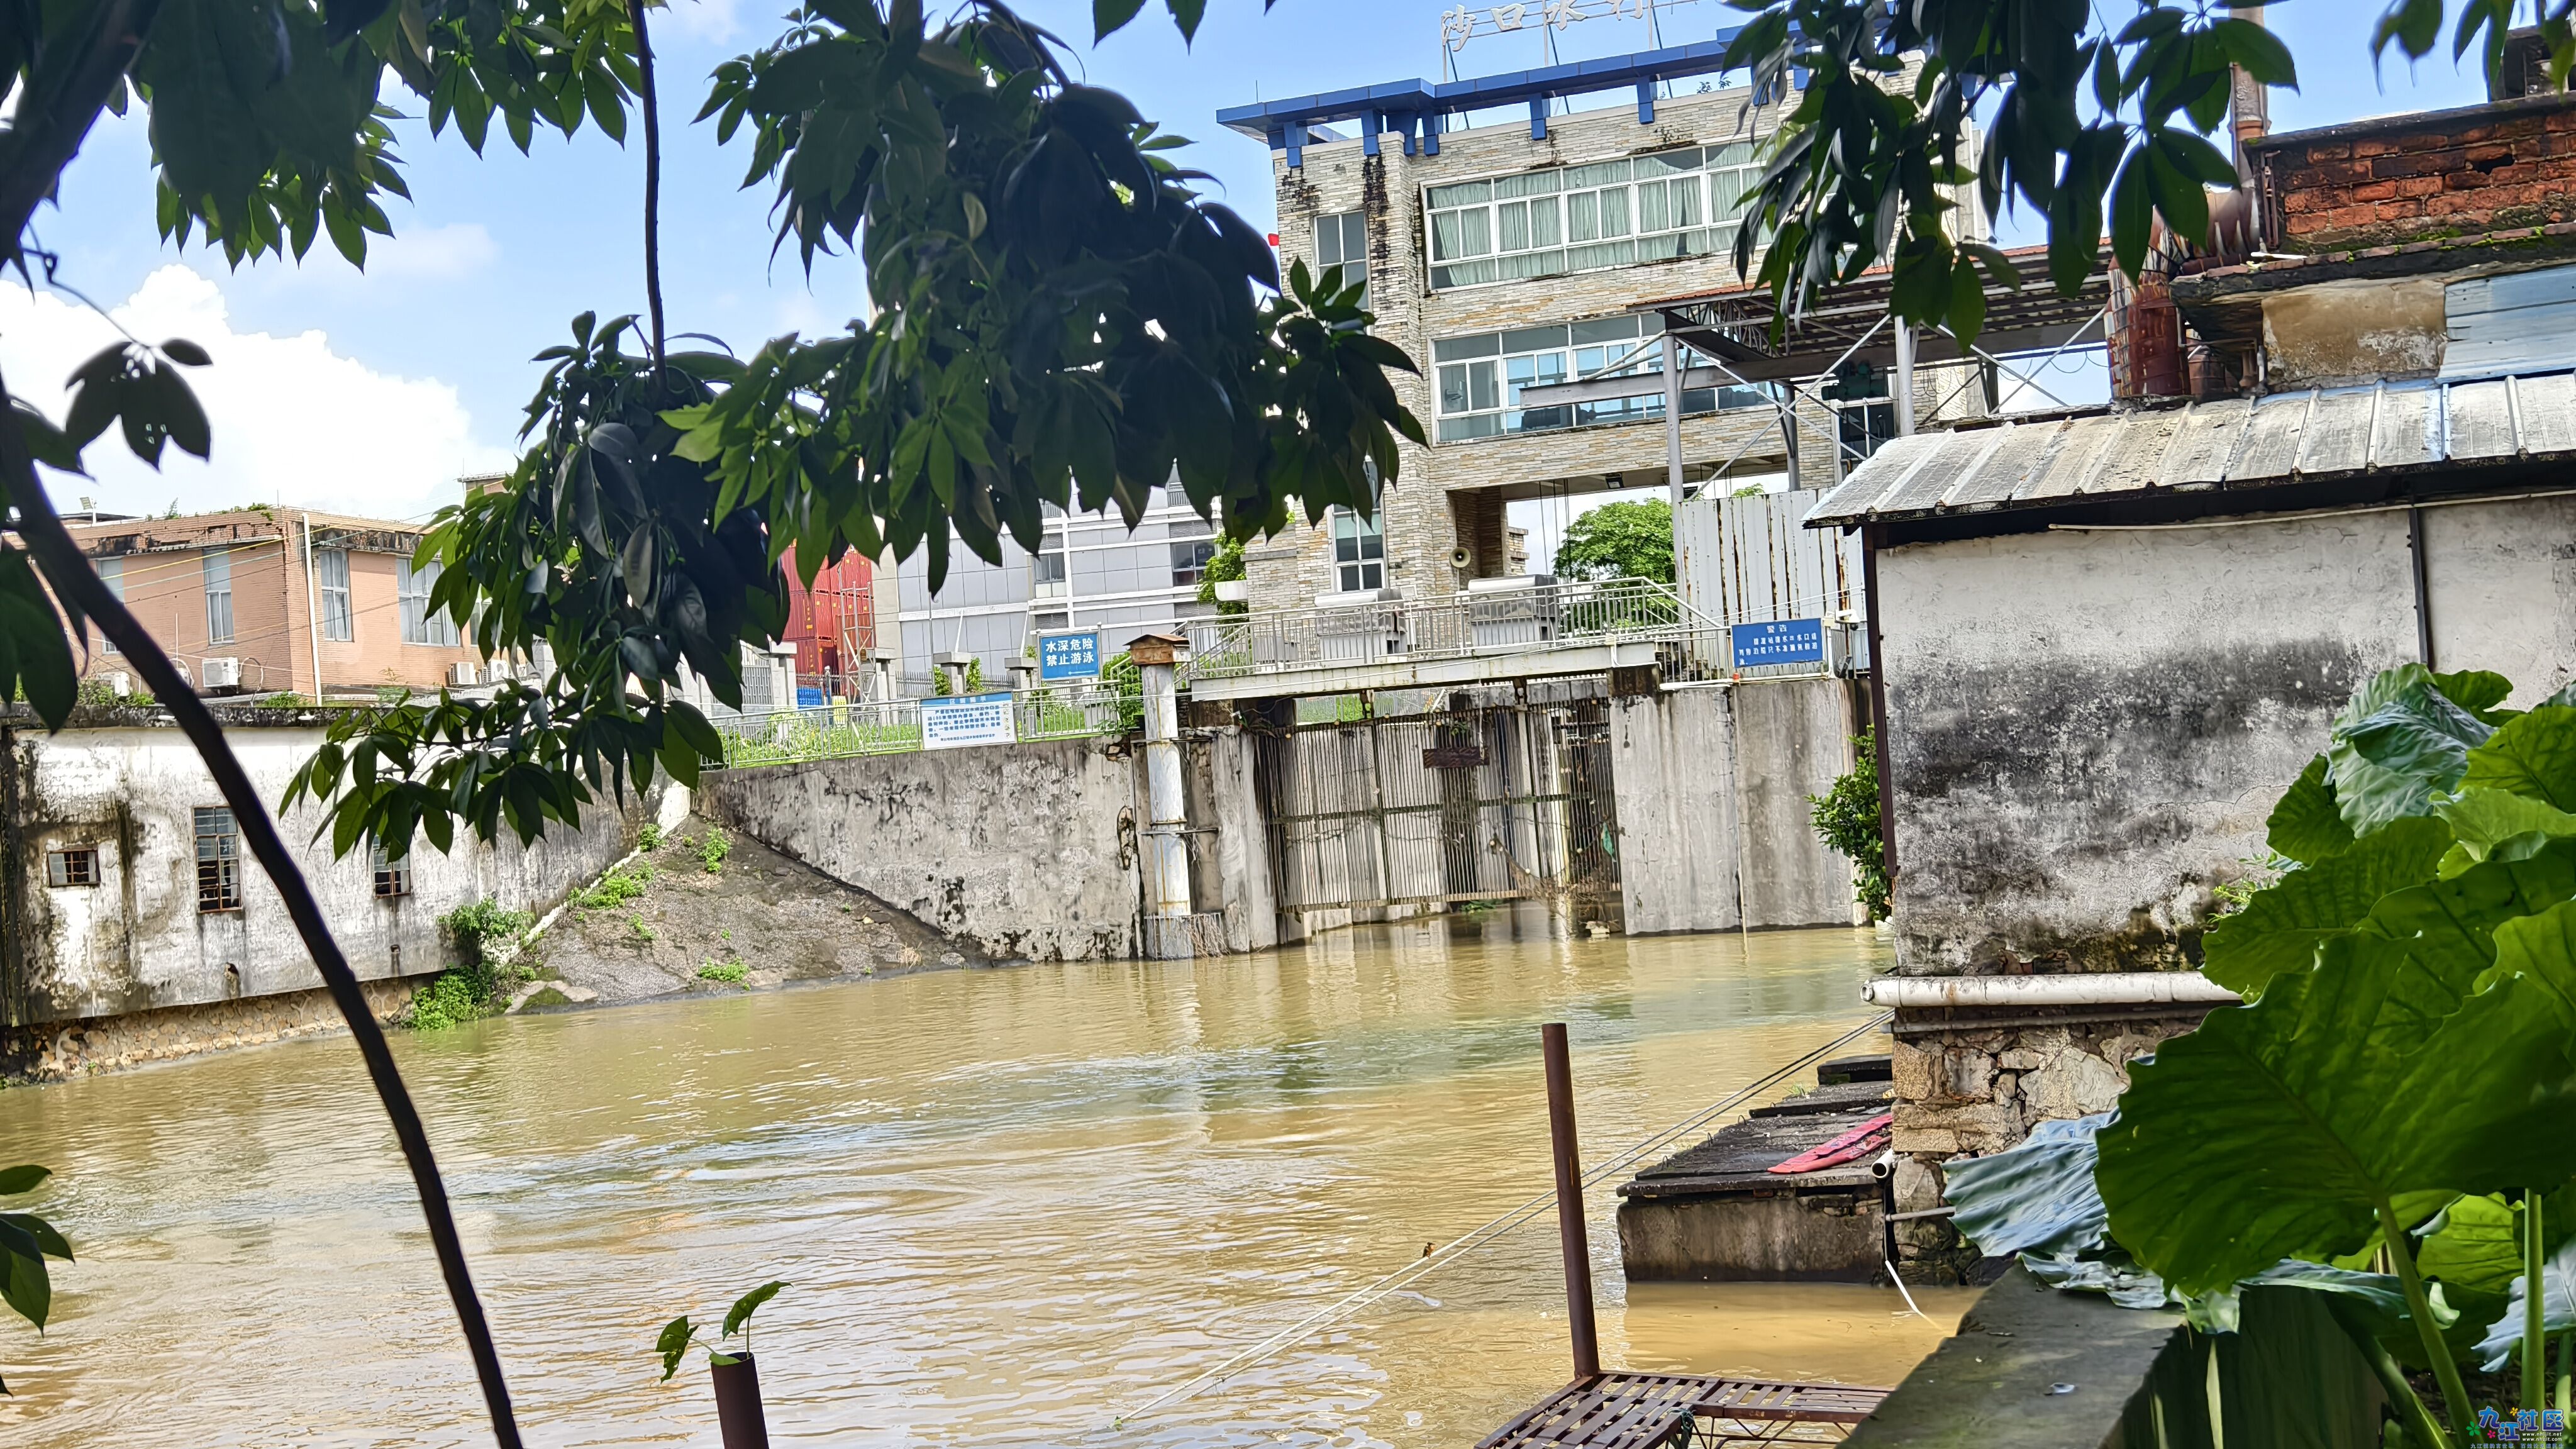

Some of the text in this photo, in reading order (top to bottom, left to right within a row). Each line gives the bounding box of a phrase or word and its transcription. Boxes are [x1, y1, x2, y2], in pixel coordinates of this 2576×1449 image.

[1045, 637, 1094, 652] 水深危险
[1046, 651, 1094, 667] 禁止游泳
